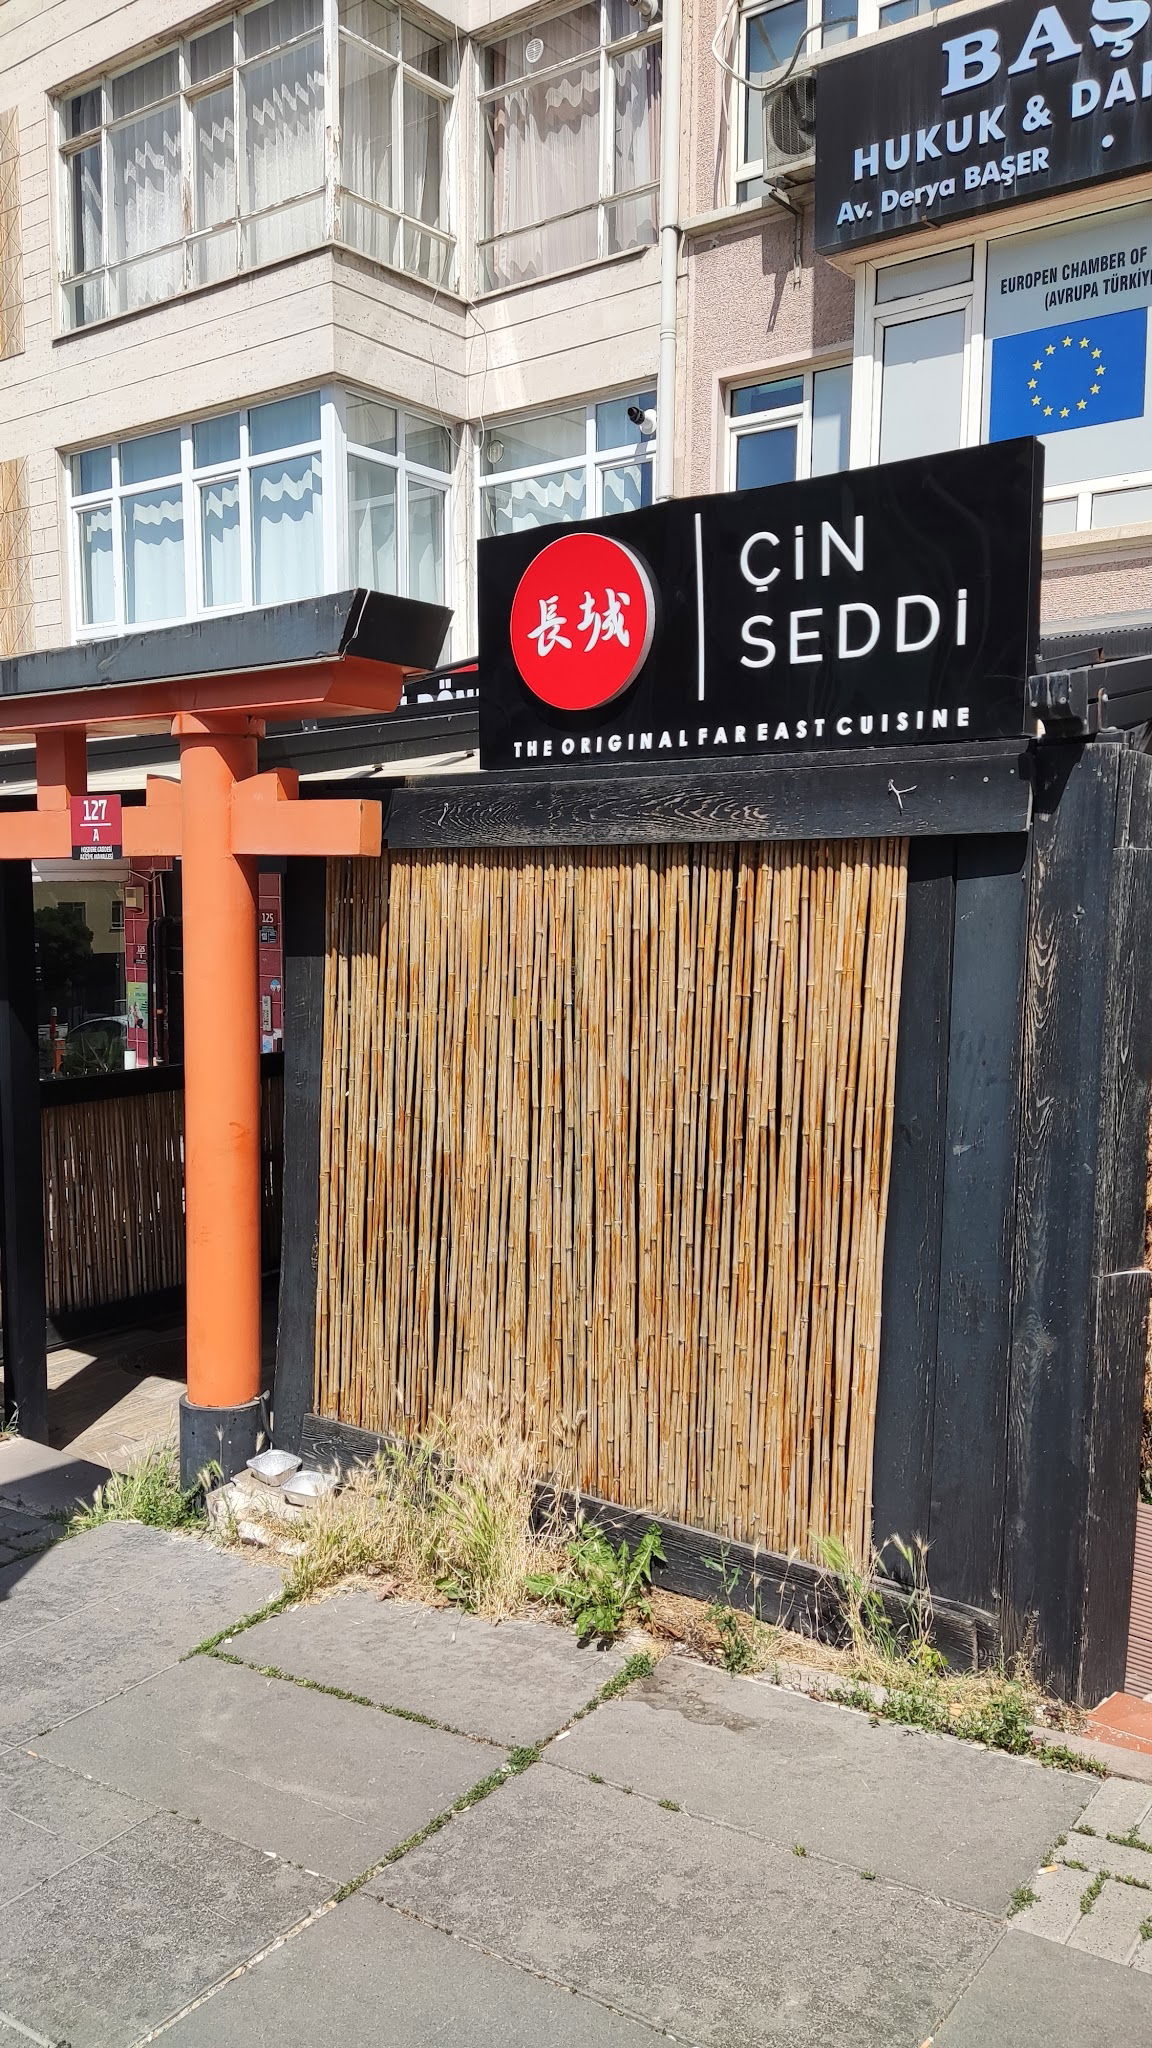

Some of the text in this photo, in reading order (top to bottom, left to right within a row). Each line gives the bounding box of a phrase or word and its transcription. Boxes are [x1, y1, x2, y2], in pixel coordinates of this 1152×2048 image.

[853, 104, 1006, 181] HUKUK
[1022, 94, 1053, 132] &
[836, 146, 1050, 226] Av. Derya BAŞER
[1000, 246, 1148, 295] EUROPEN CHAMBER OF
[1044, 281, 1099, 311] (AVRUPA
[527, 588, 631, 657] 長城
[514, 707, 970, 758] THE ORIGINAL FAR EAST CUISINE
[83, 799, 108, 821] 127
[92, 828, 100, 842] A
[261, 912, 274, 923] 125
